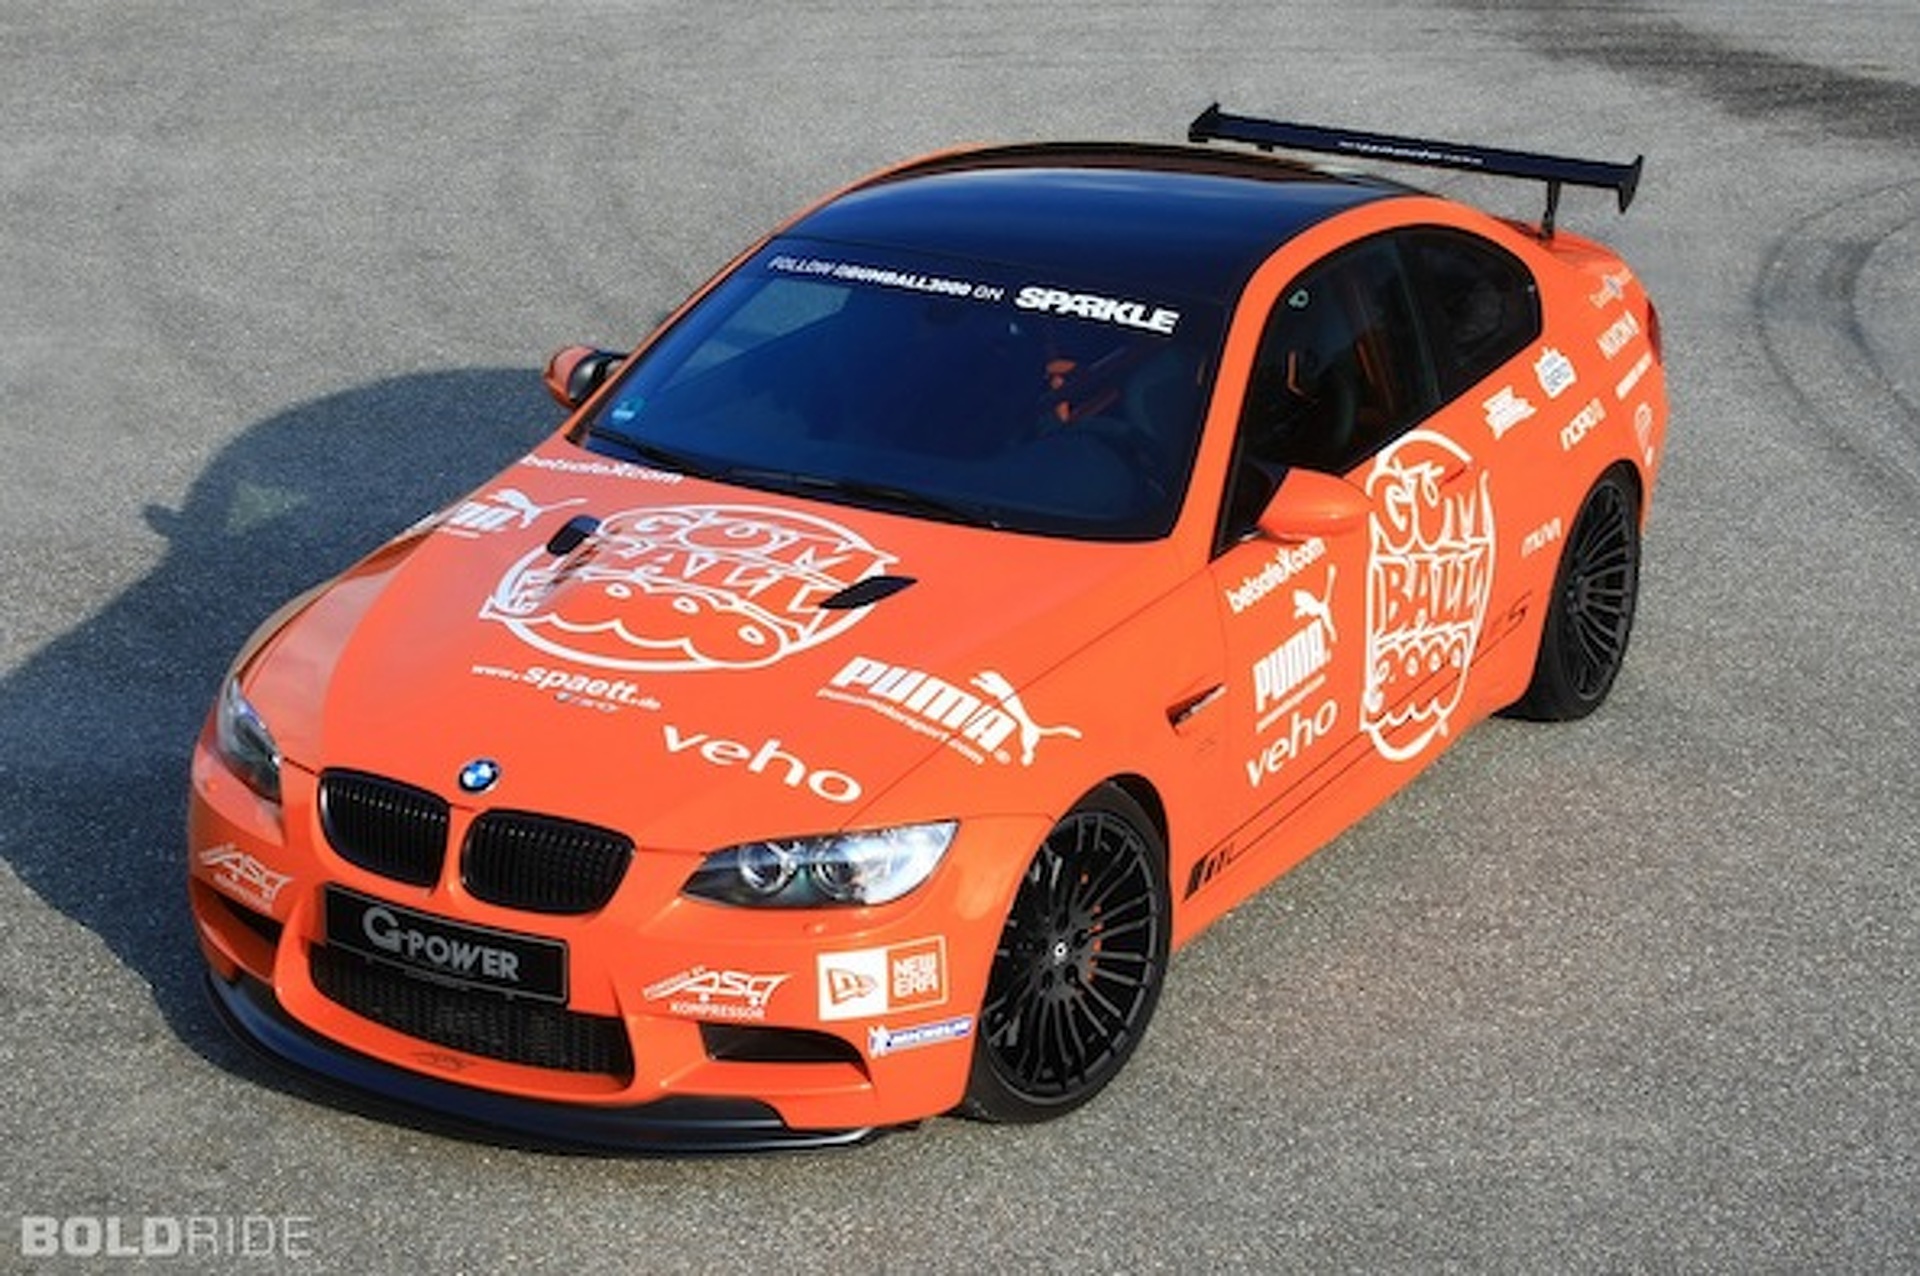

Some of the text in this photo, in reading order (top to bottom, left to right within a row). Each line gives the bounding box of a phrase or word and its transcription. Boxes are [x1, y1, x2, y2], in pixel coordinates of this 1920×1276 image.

[973, 285, 1004, 301] ON
[1015, 286, 1180, 335] SPARKLE
[828, 655, 1018, 754] PUMA
[1246, 699, 1338, 788] veho
[662, 724, 862, 804] veho
[362, 905, 520, 983] G-POWER
[893, 952, 938, 979] NEW
